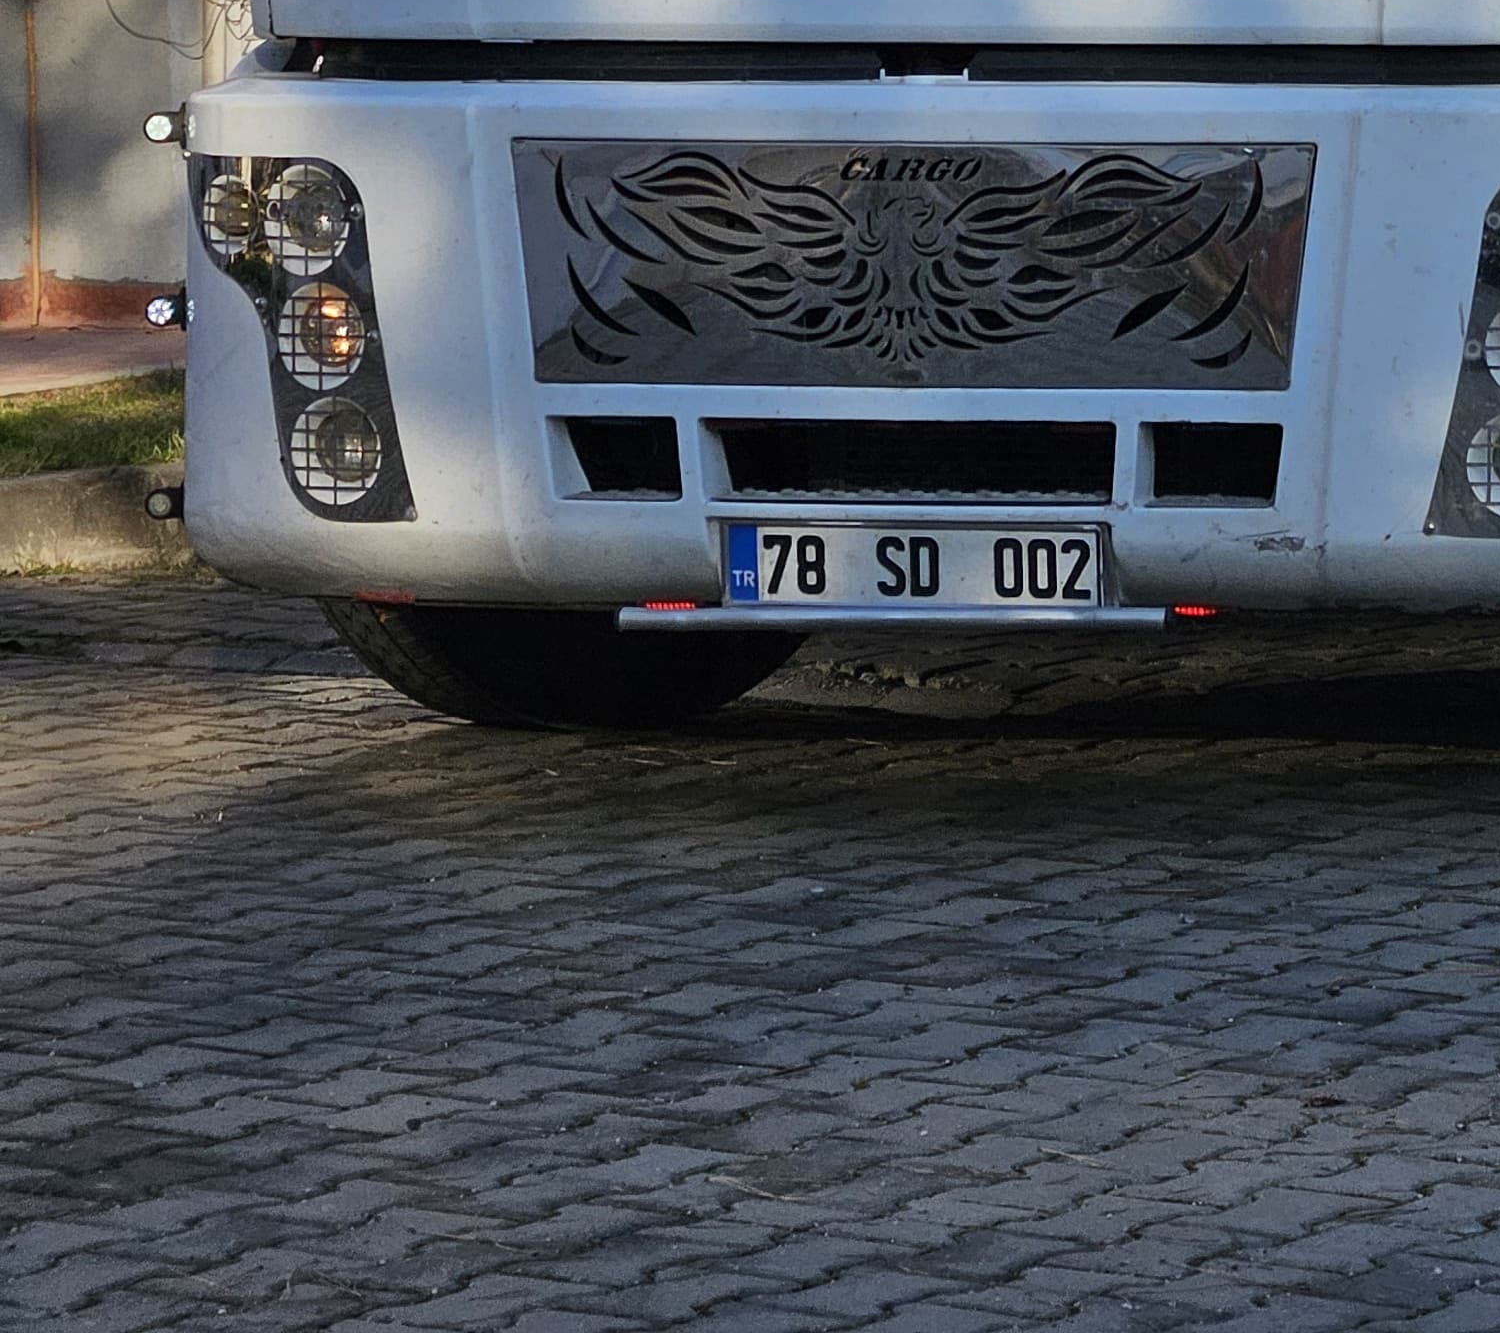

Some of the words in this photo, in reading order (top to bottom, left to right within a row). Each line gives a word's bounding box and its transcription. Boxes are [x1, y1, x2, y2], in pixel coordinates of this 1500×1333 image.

[840, 154, 984, 182] CARGO
[732, 569, 755, 589] TR
[762, 534, 826, 596] 78
[876, 536, 939, 598] SD
[993, 537, 1091, 601] 002
